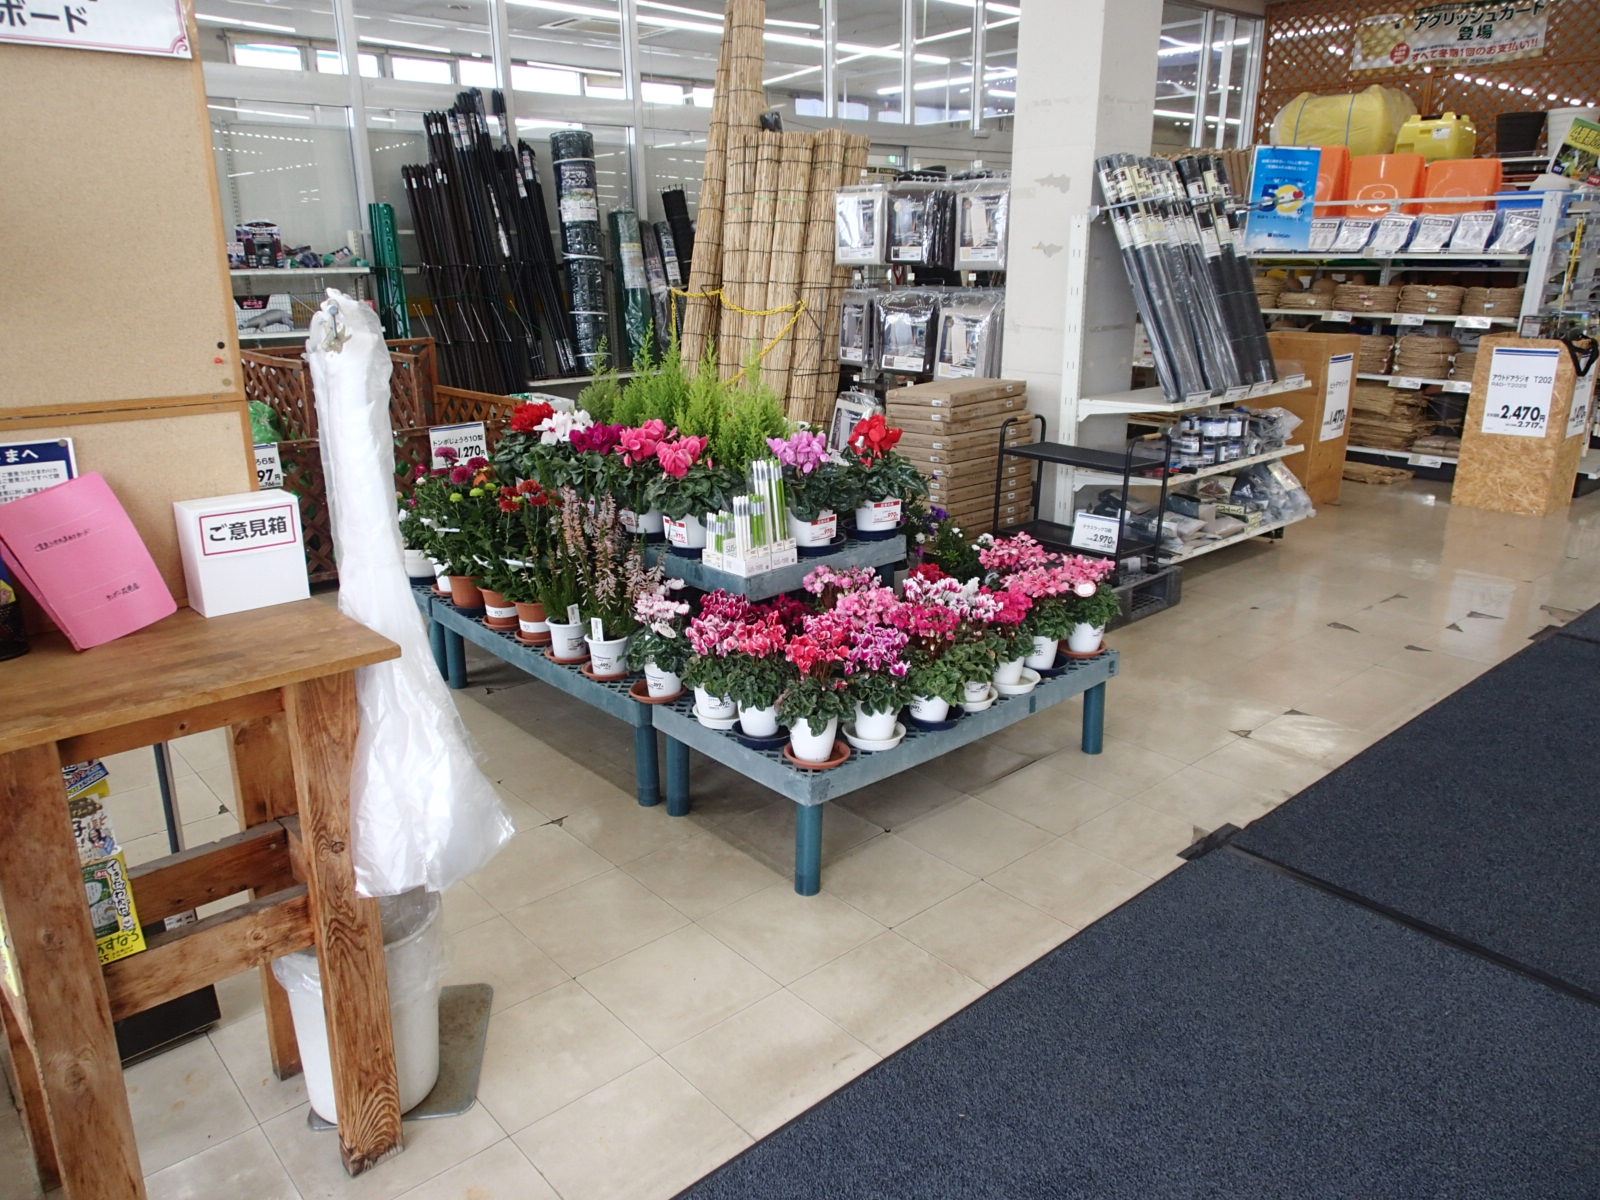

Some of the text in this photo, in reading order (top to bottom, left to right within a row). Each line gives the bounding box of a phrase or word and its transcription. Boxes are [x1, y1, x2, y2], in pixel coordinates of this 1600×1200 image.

[0, 0, 88, 33] ボード
[1457, 24, 1493, 40] 登場
[1492, 373, 1553, 384] アウトドアラジオ T202
[1501, 404, 1546, 422] 2,470円
[433, 434, 483, 447] トンボじょうろ10型
[0, 449, 39, 463] まへ
[210, 516, 287, 542] ご意見箱
